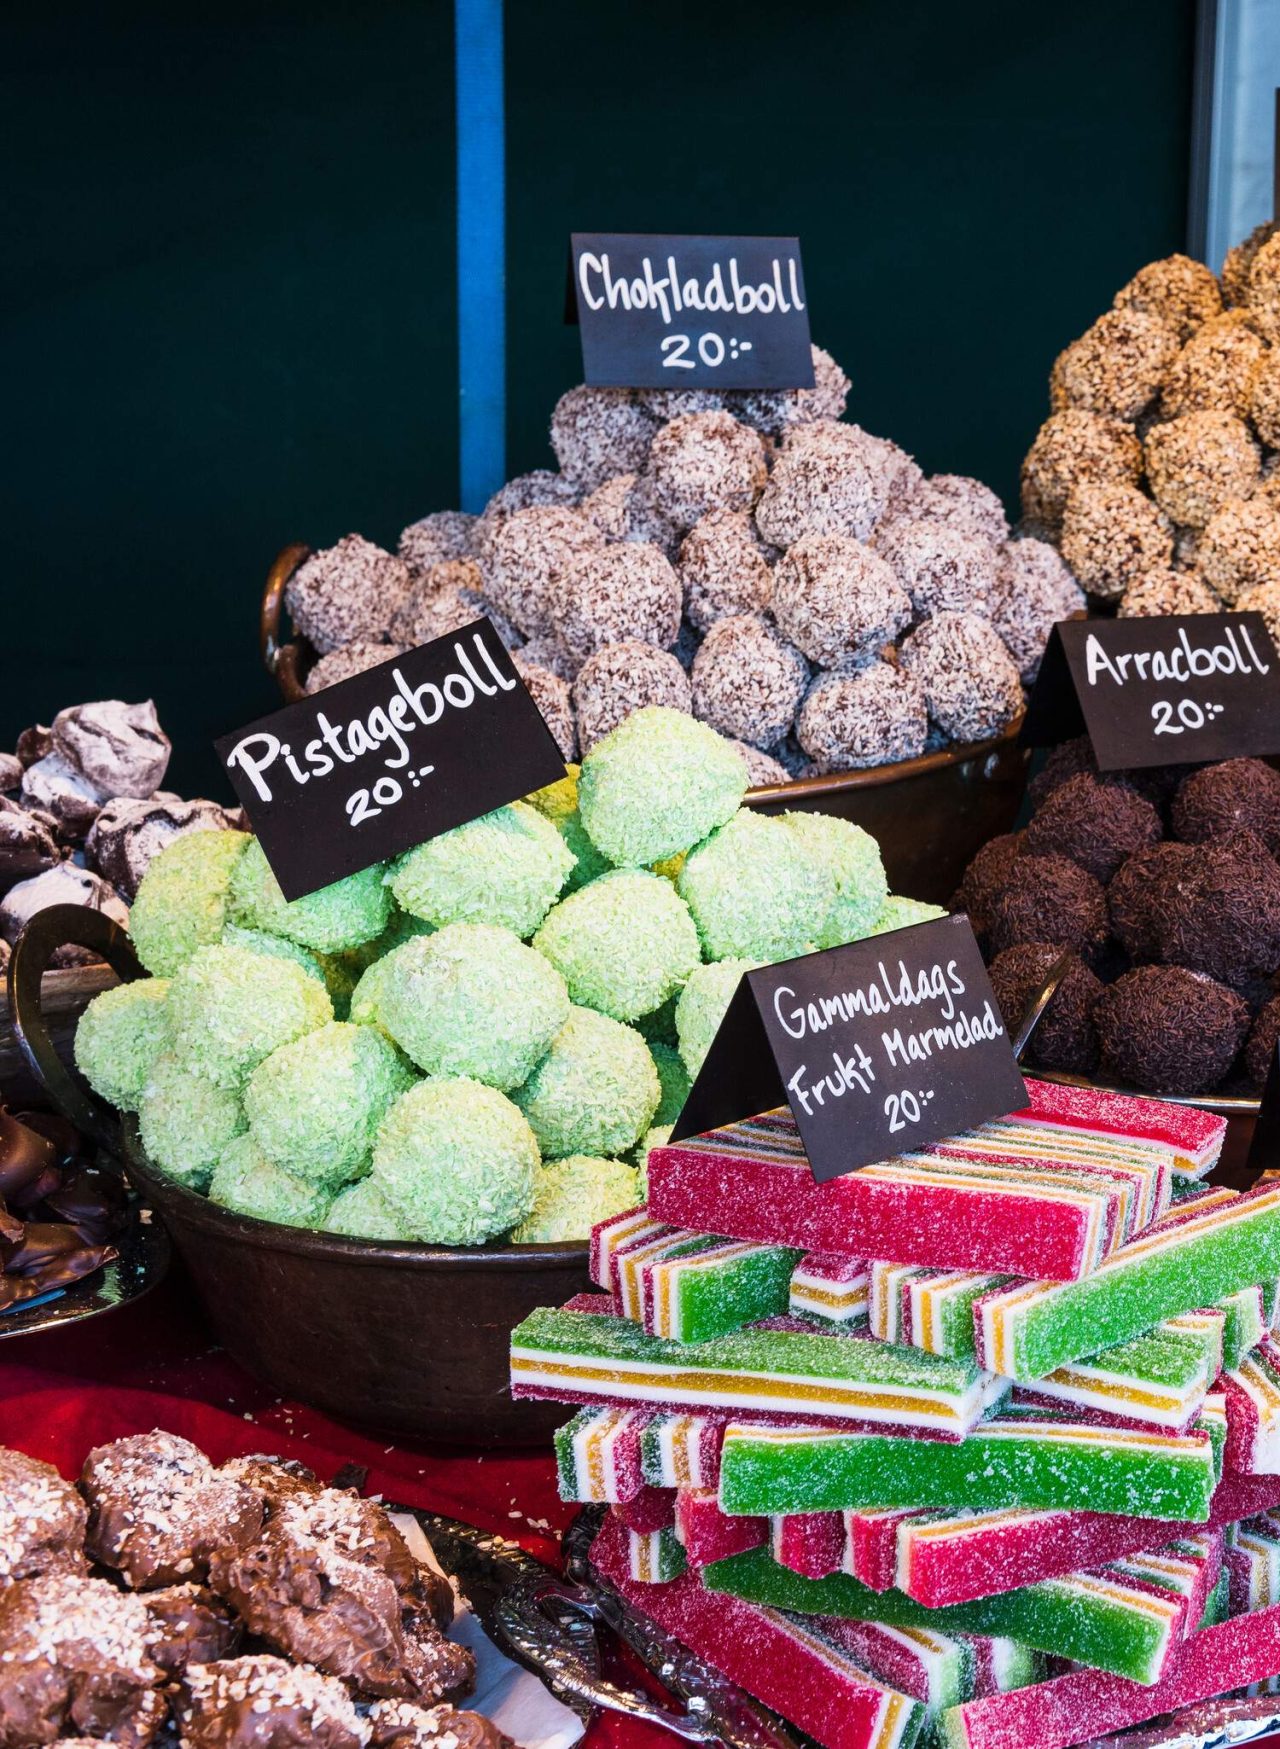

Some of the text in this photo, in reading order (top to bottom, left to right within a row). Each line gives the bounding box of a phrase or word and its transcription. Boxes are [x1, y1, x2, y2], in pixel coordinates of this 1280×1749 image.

[578, 252, 806, 325] Chokladboll
[660, 331, 753, 369] 20:-
[1085, 623, 1270, 686] Arracboll
[226, 633, 517, 802] Pistageboll
[1151, 698, 1225, 736] 20:-
[345, 764, 435, 827] 20:-
[773, 959, 967, 1040] Gammaldags
[787, 1000, 1004, 1117] Frukt Marmelad
[884, 1089, 935, 1134] 20:-
